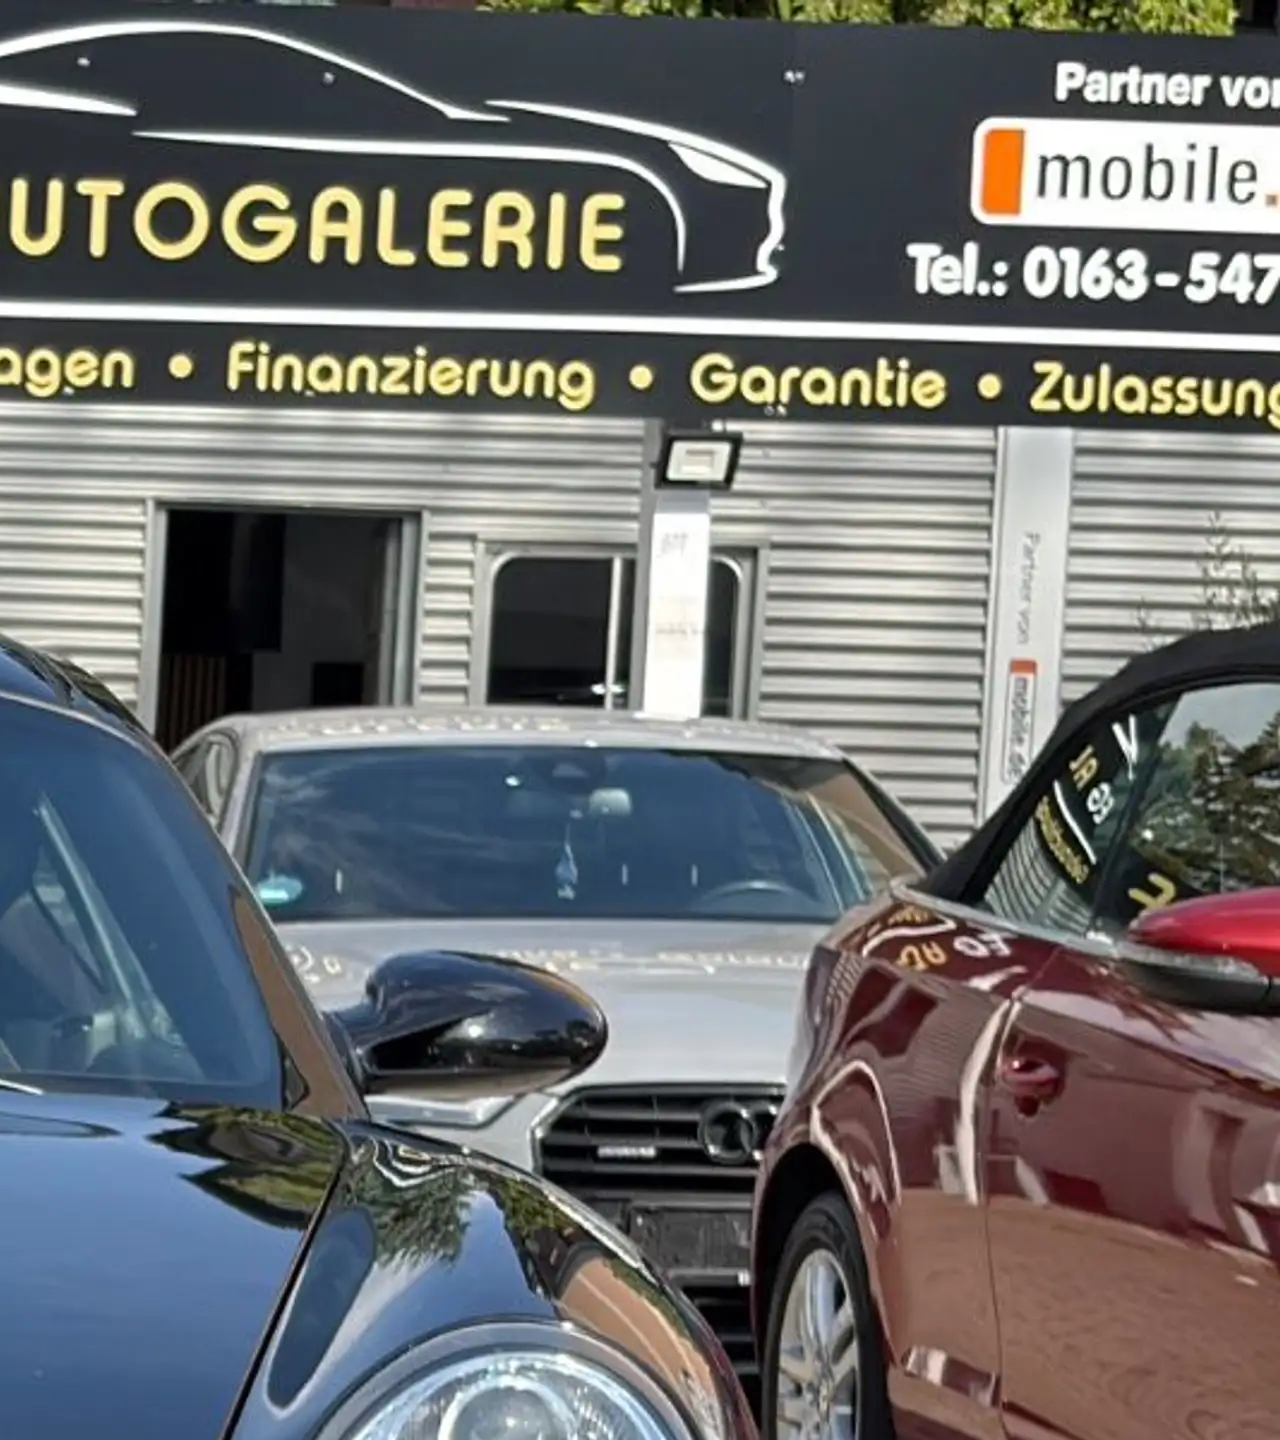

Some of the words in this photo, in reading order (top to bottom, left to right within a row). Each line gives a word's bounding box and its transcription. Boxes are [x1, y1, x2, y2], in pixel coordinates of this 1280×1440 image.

[1055, 61, 1213, 106] Partner
[906, 243, 1009, 297] Tel.:
[227, 340, 596, 412] Finanzierung
[689, 352, 948, 410] Garantie
